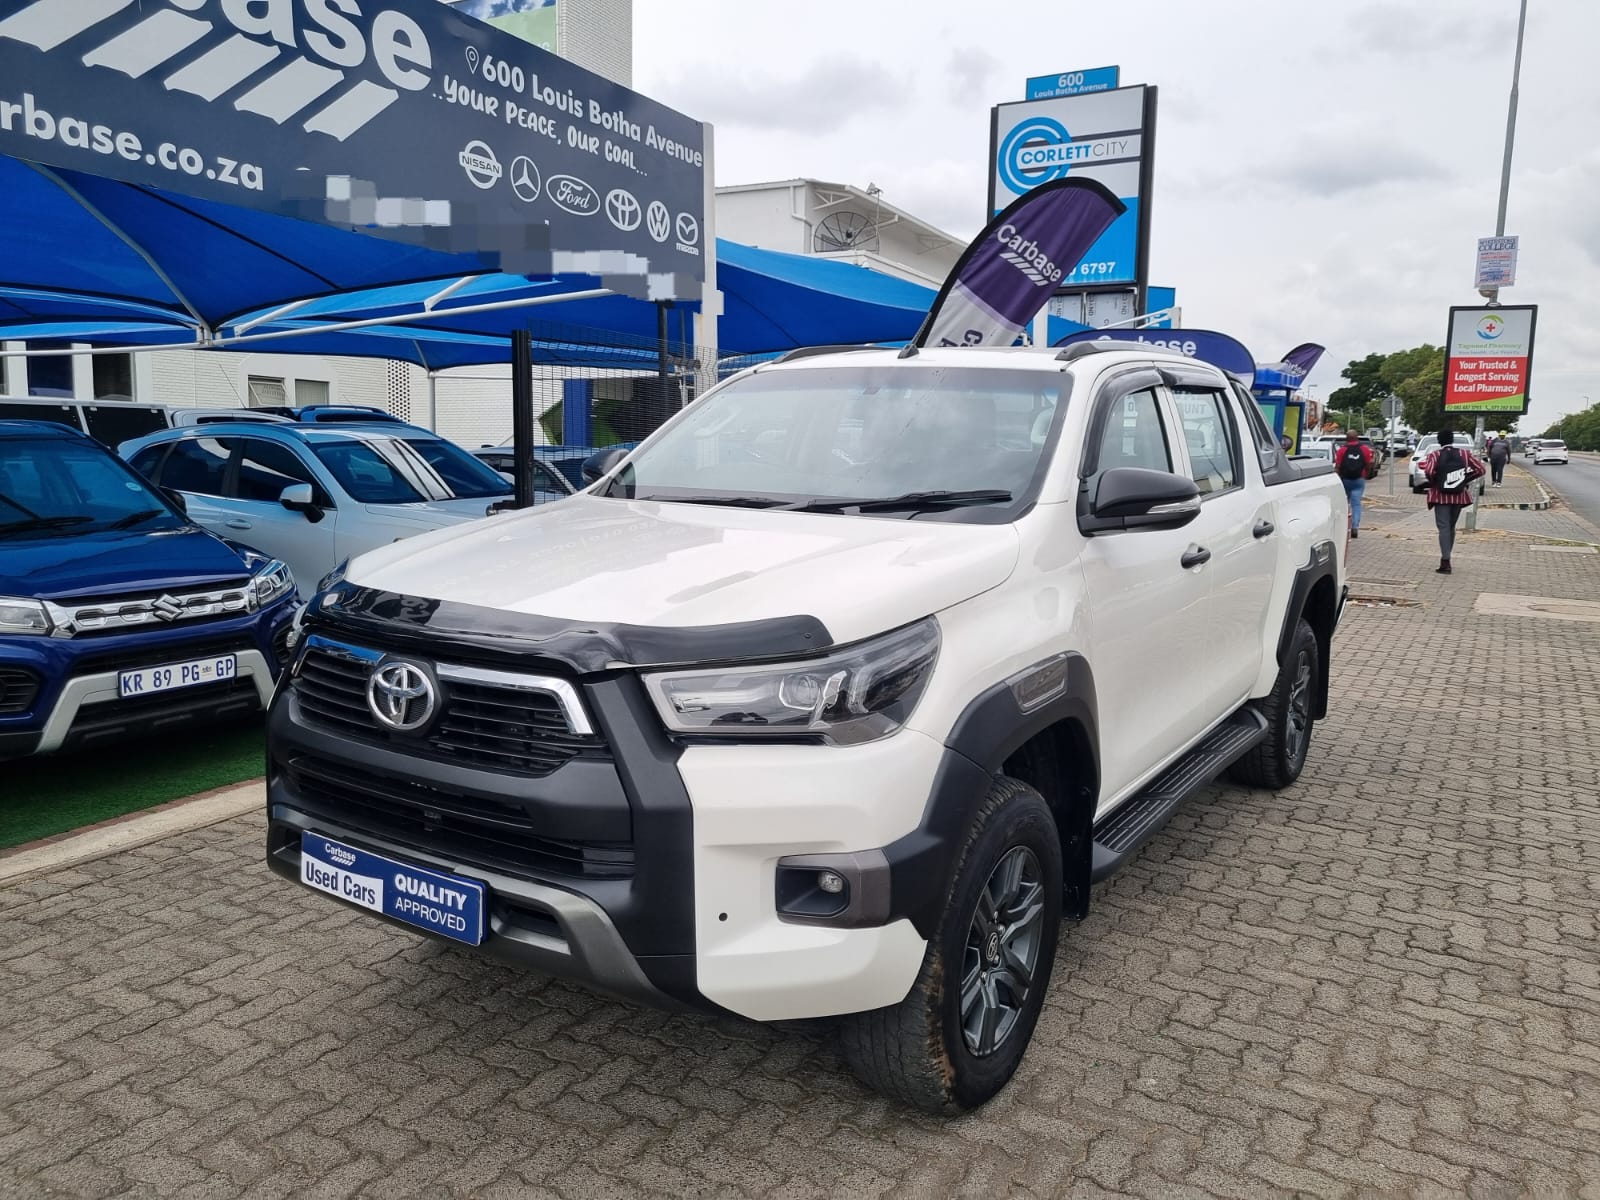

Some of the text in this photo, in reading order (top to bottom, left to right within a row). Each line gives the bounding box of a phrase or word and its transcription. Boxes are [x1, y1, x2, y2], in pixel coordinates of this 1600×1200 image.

[1034, 89, 1054, 99] Louis
[1078, 82, 1108, 94] Avenue
[1058, 73, 1084, 88] 600
[482, 55, 703, 168] 600 Louis Botha Avenue
[505, 100, 562, 145] PEACE,
[567, 125, 600, 156] OUR
[461, 154, 501, 174] NISSAN
[556, 180, 593, 209] Ford
[997, 224, 1062, 283] Carbase
[1080, 261, 1116, 276] 6797
[1459, 361, 1517, 369] Your Trusted &
[1454, 372, 1519, 383] Longest Serving
[1454, 384, 1518, 394] Local Pharmacy
[122, 658, 234, 694] KR 89 PG GP
[325, 843, 356, 863] Carbase
[306, 860, 376, 905] Used Cars
[394, 873, 468, 911] QUALITY
[395, 896, 467, 932] APPROVED
